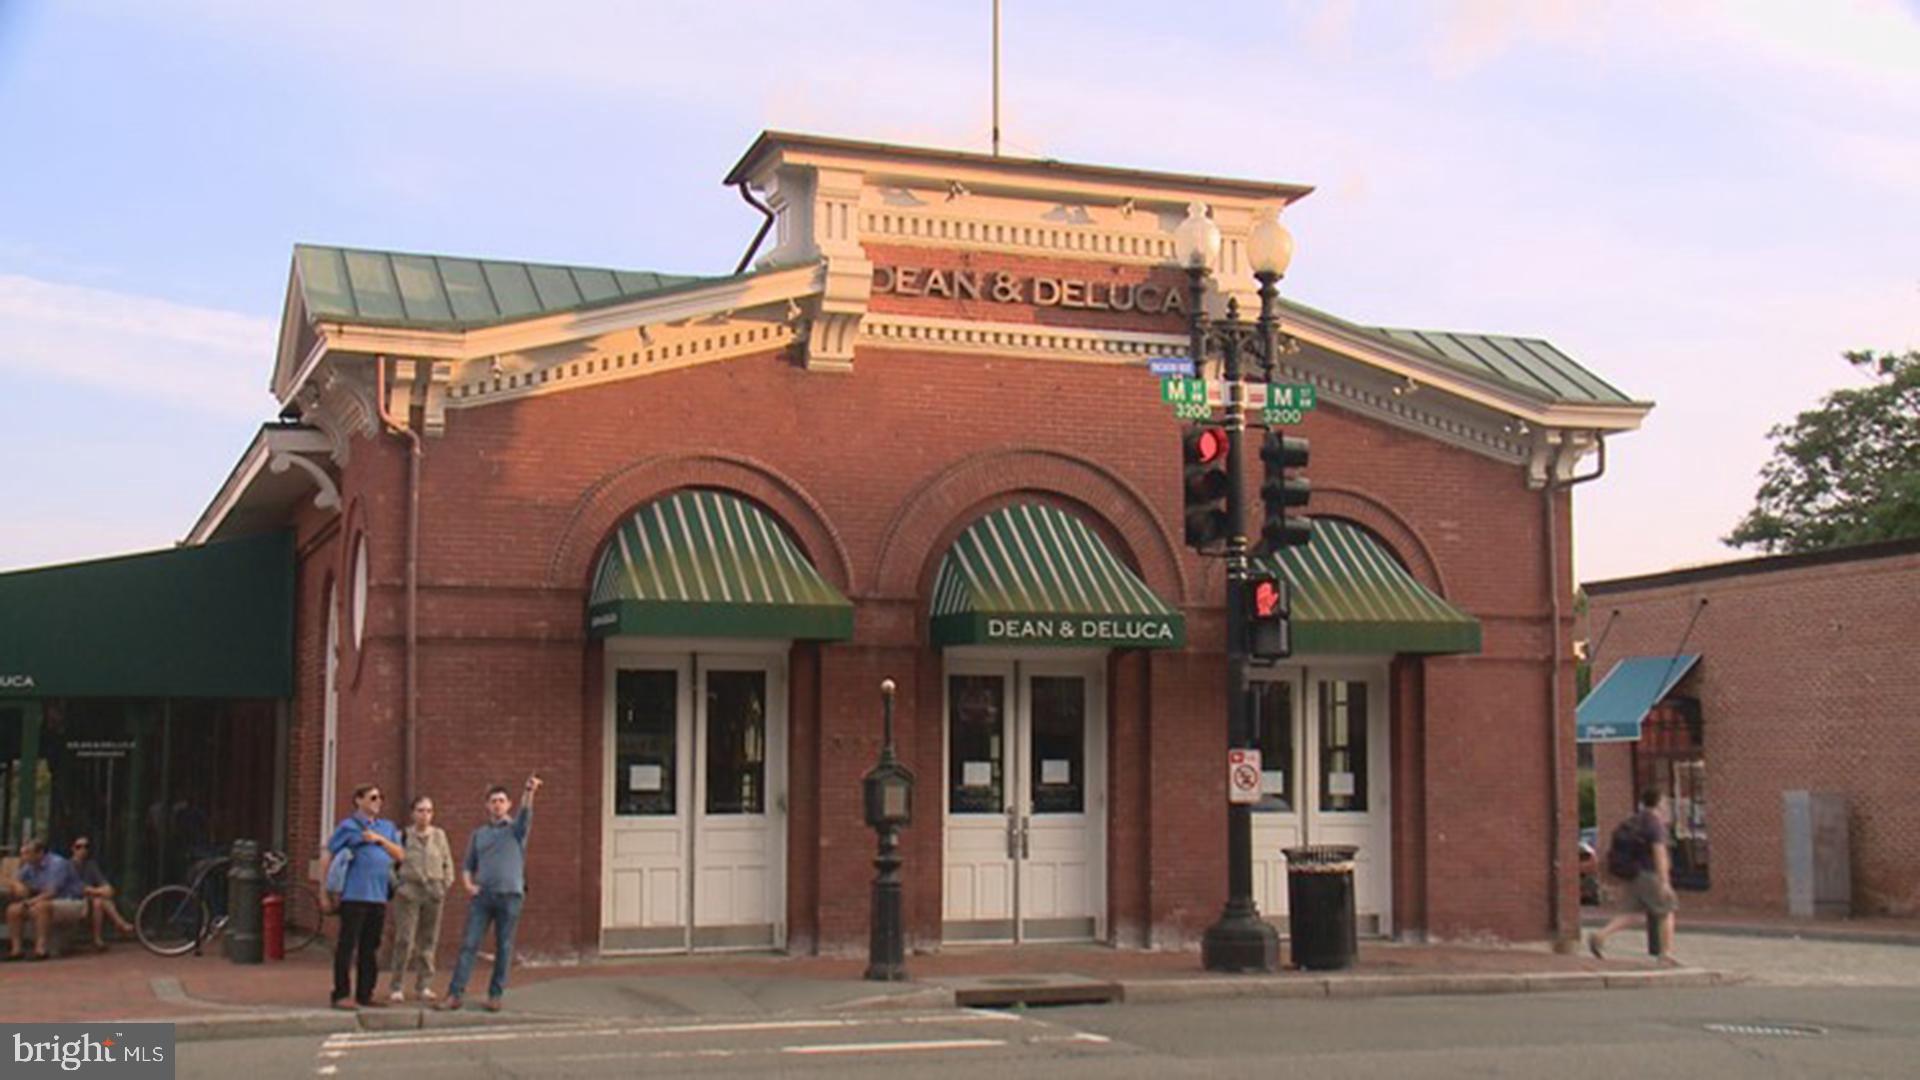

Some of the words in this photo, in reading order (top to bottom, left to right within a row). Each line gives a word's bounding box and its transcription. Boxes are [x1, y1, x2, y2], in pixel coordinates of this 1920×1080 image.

[871, 266, 981, 299] DEAN
[993, 270, 1023, 302] &
[1033, 278, 1187, 313] DELUCA
[1168, 381, 1185, 400] M
[1274, 387, 1293, 407] M
[1176, 403, 1211, 418] 3200
[1264, 409, 1301, 423] 3200
[988, 619, 1054, 638] DEAN
[1059, 620, 1075, 638] &
[1082, 621, 1174, 640] DELUCA
